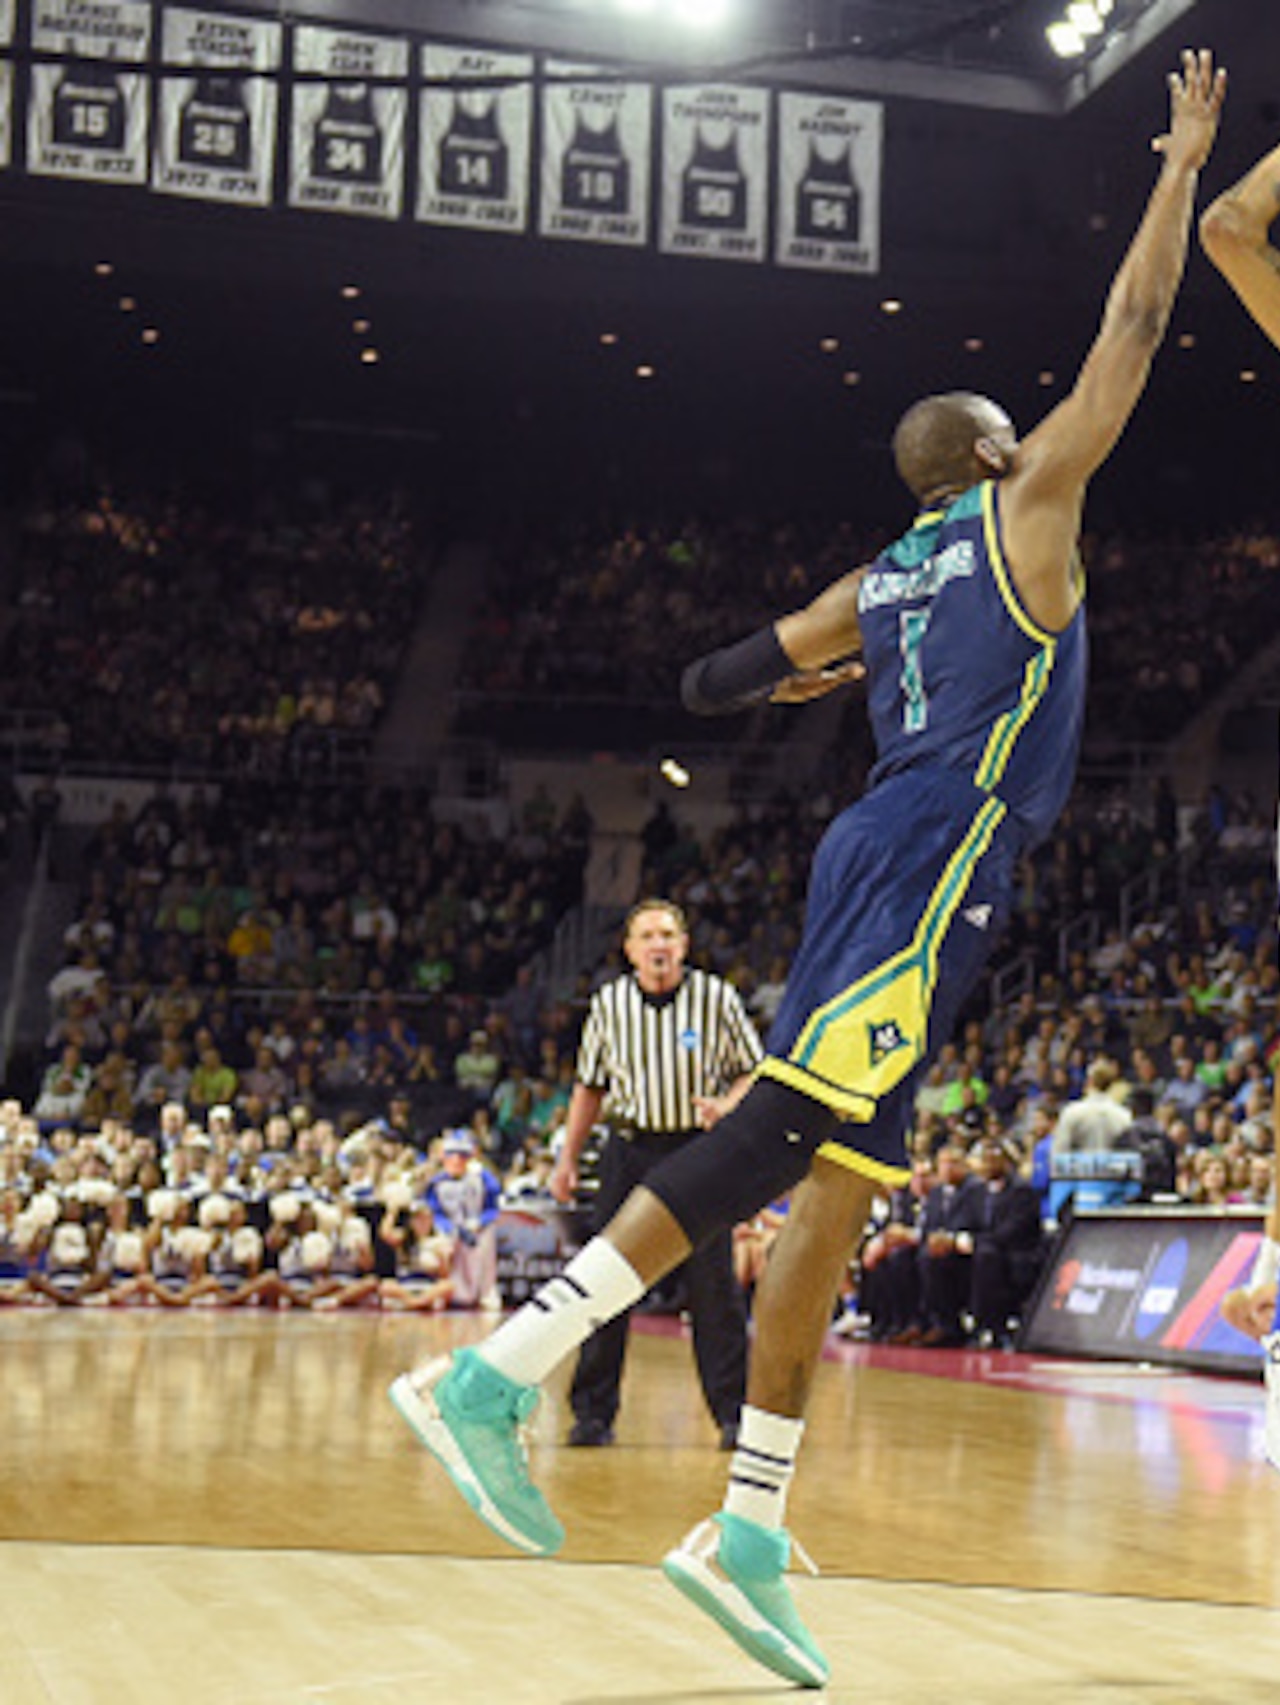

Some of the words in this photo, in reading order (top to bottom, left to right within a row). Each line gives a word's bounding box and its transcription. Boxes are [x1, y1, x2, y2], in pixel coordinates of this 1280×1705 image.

[72, 104, 109, 137] 15
[324, 139, 366, 171] 34
[456, 156, 490, 186] 14
